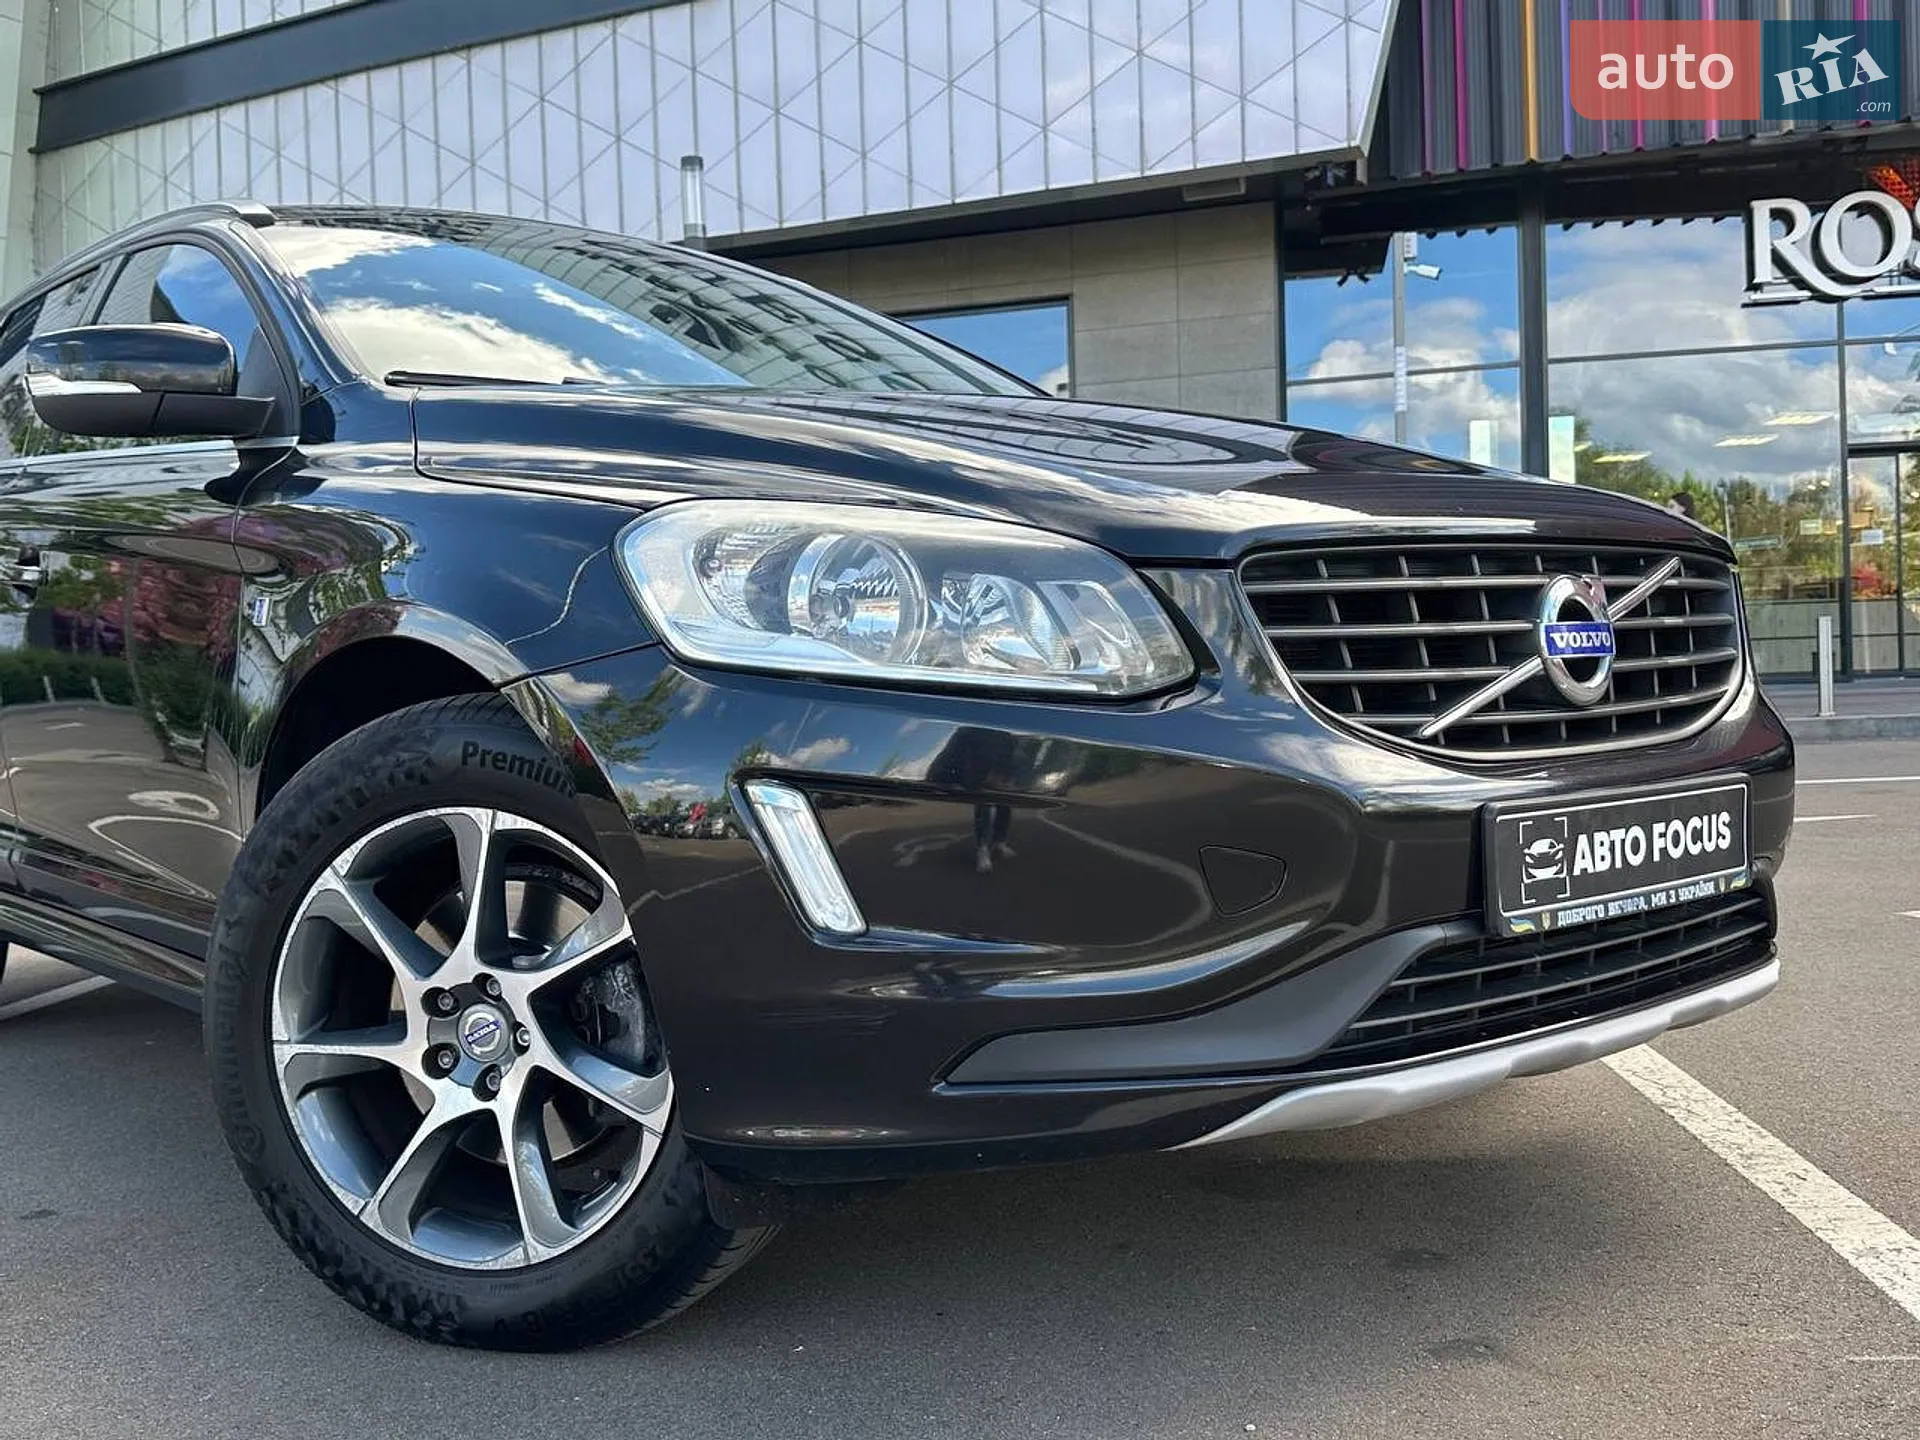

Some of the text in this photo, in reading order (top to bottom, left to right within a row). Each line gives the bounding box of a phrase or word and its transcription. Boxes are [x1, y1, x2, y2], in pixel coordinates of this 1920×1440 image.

[1750, 190, 1920, 296] RO
[1549, 631, 1611, 648] VOLVO
[1572, 811, 1731, 876] АВТО FOCUS
[1557, 903, 1605, 928] ДОБРОГО
[1651, 890, 1668, 908] МИ
